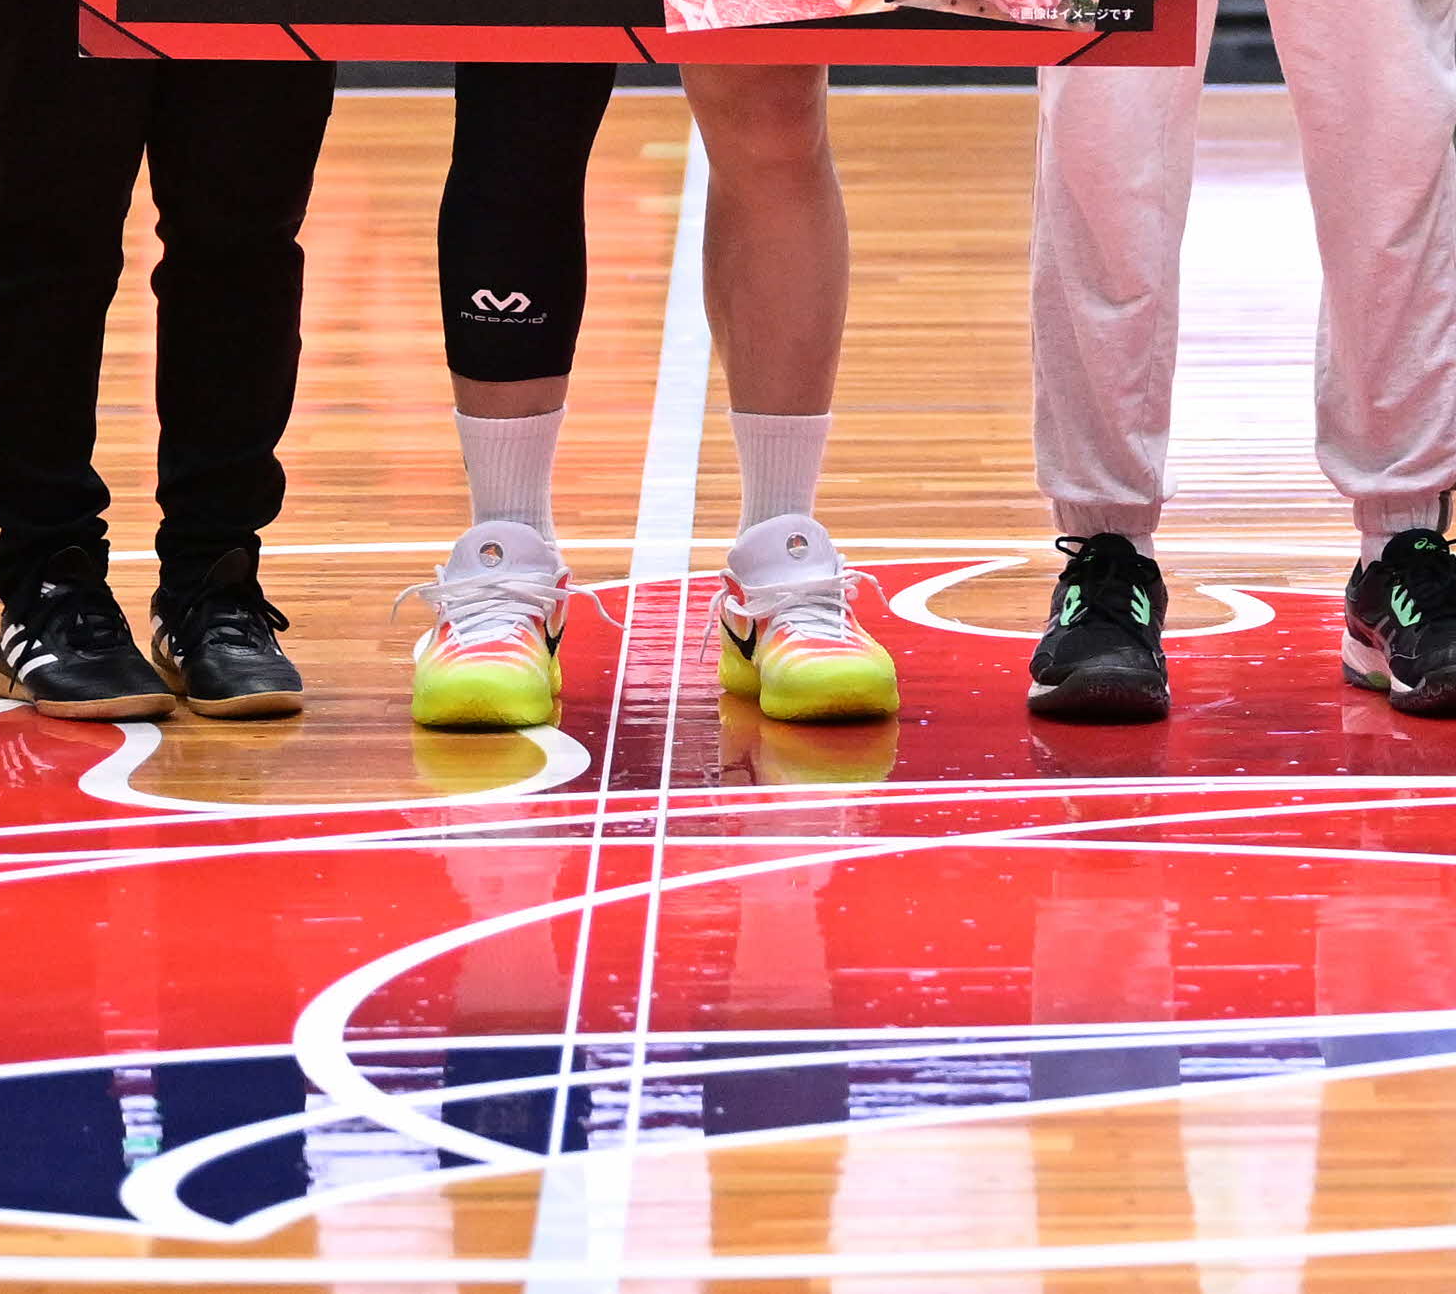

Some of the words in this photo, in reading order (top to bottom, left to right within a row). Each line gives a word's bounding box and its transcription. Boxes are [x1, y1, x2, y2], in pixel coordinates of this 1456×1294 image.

[1009, 6, 1134, 22] ※画像はイメージです
